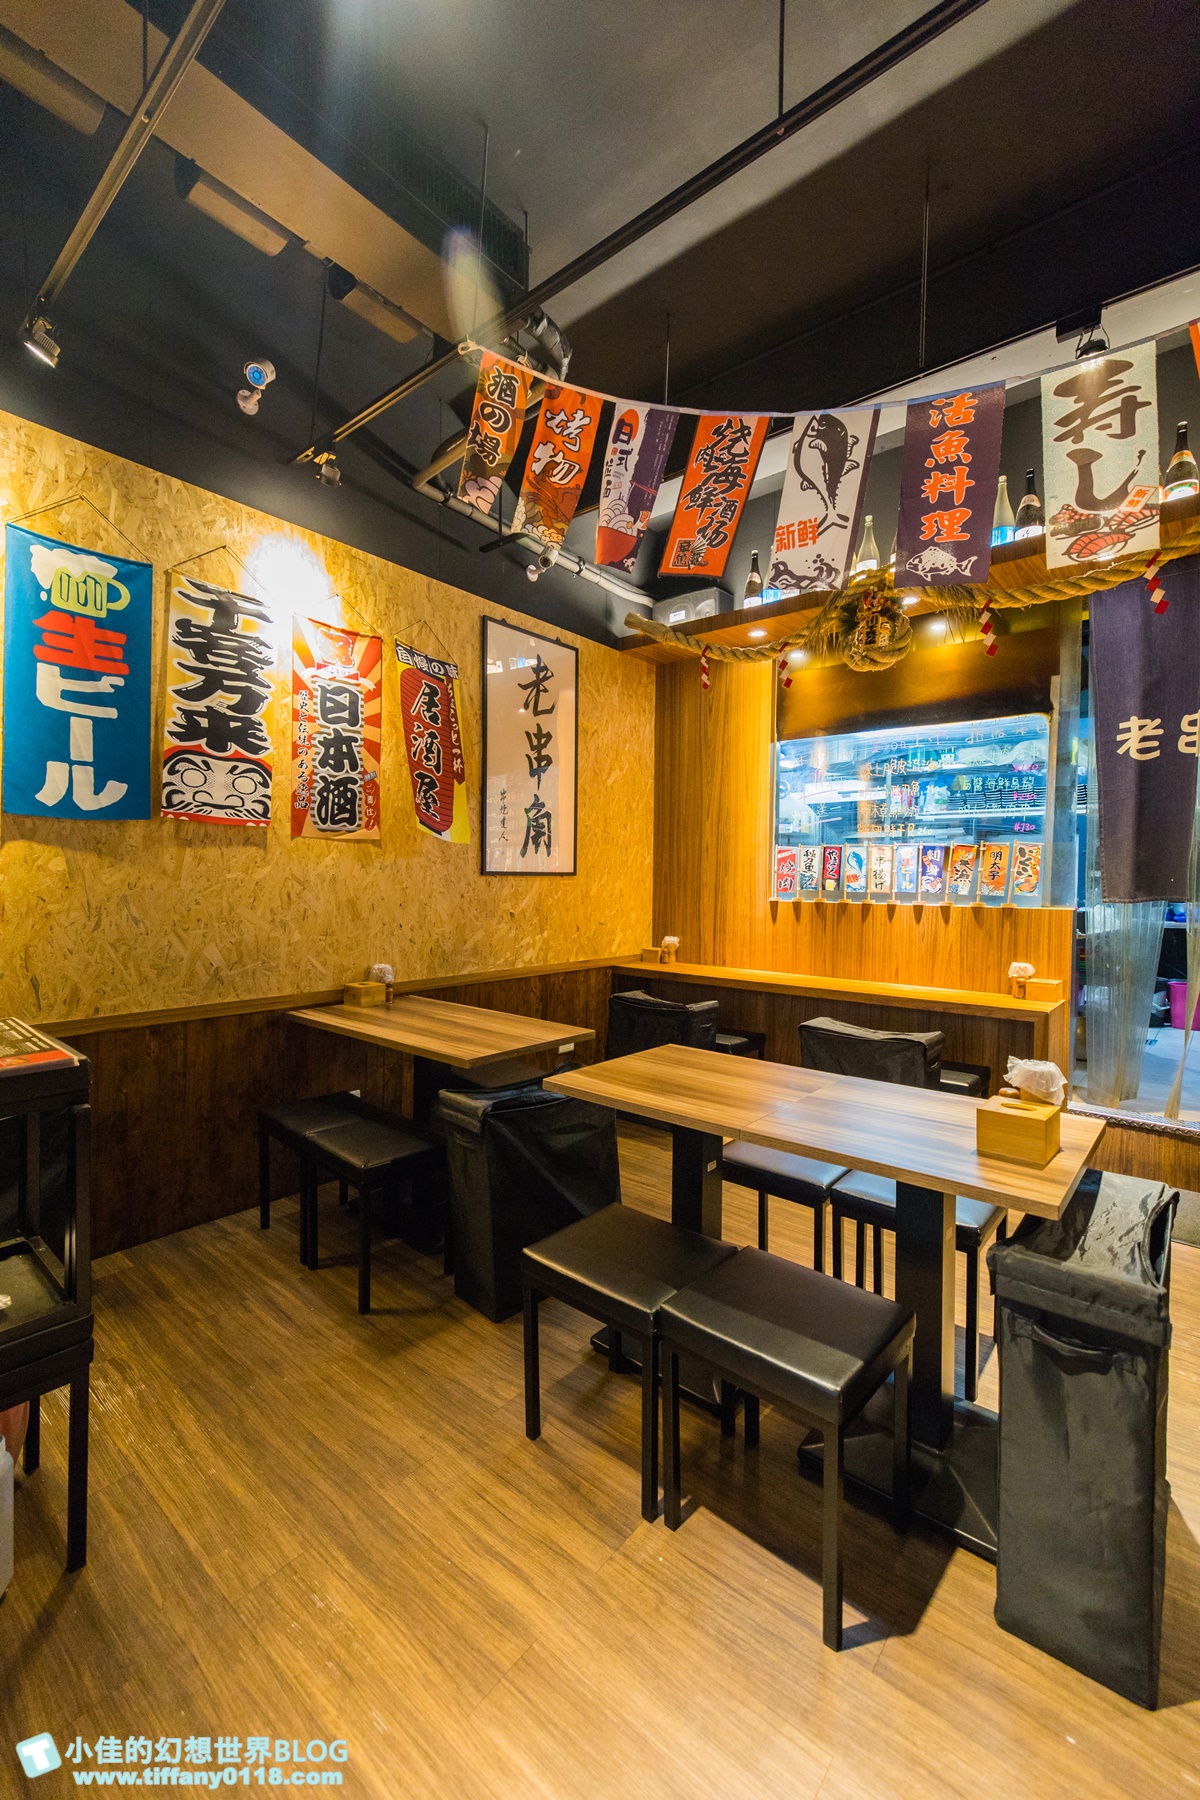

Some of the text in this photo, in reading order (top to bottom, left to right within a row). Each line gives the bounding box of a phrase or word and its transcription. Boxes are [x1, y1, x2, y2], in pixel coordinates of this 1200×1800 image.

[531, 408, 592, 485] 烤物
[611, 418, 634, 472] 日式
[919, 392, 978, 543] 活魚料理
[1052, 359, 1153, 512] 寿し
[32, 608, 131, 811] 生ビール
[396, 646, 459, 680] 自慢の味
[315, 682, 361, 828] 日本酒
[410, 679, 443, 822] 居酒屋
[988, 850, 1003, 880] 明太子
